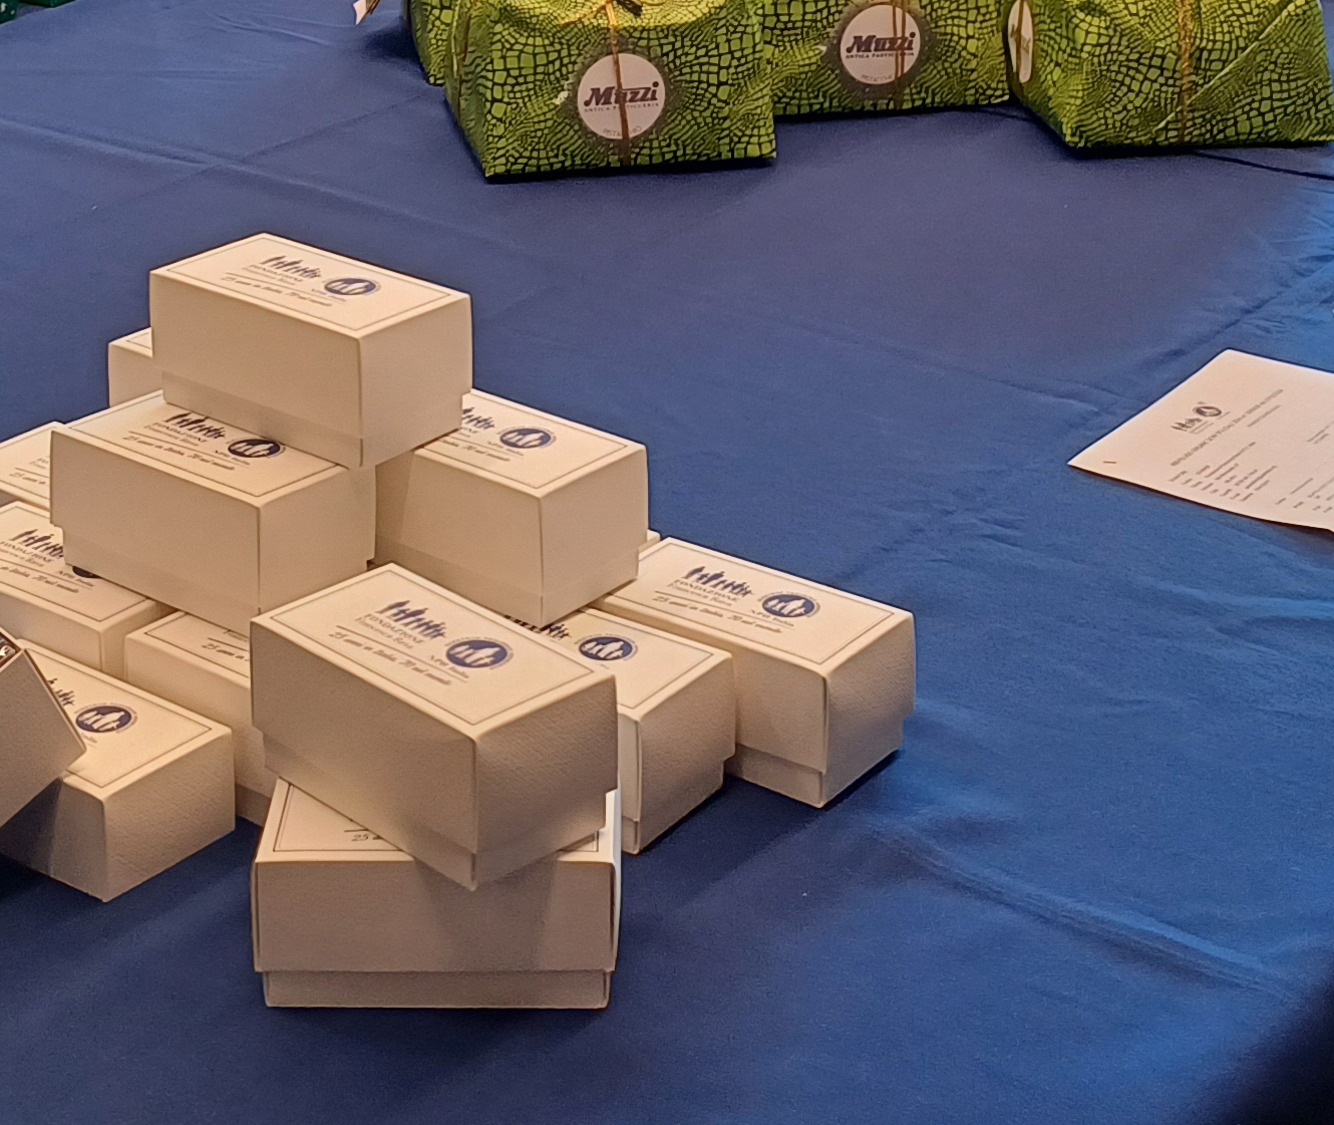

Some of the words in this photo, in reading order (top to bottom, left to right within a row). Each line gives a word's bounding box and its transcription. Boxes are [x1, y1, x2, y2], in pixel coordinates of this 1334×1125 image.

[846, 31, 916, 54] Muzzi
[583, 81, 660, 107] Muzzi
[613, 102, 660, 111] PTICCERIA
